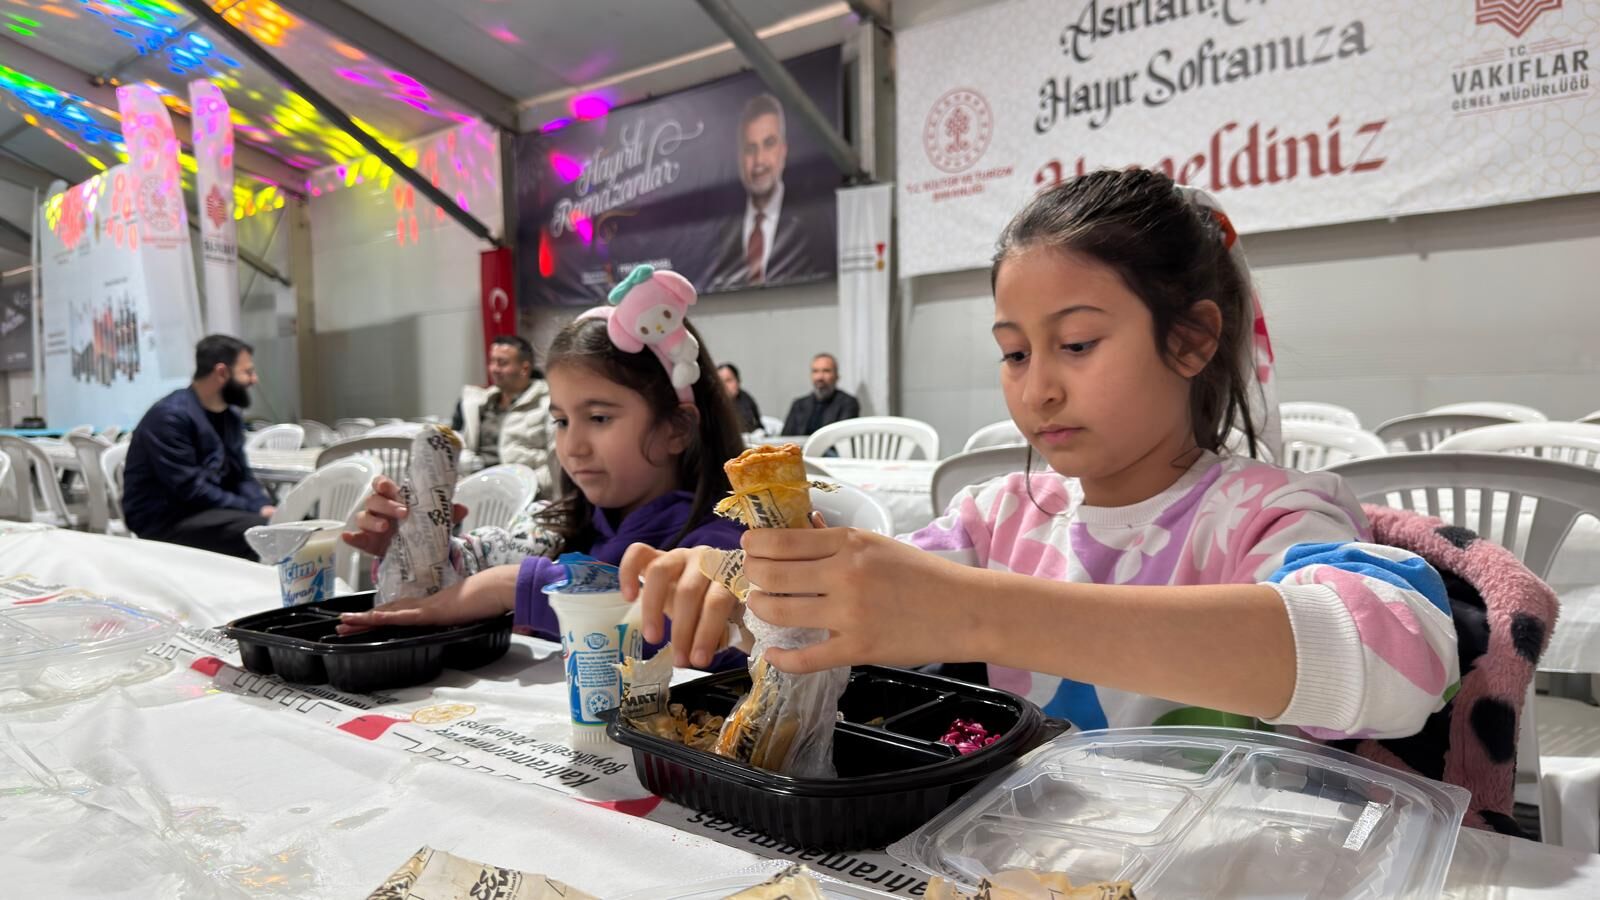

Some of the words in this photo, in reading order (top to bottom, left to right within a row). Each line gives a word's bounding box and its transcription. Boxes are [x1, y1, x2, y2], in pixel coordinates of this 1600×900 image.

[1034, 69, 1139, 135] Hayır
[1143, 18, 1374, 107] Soframıza
[1451, 95, 1493, 112] GENEL
[1499, 74, 1590, 103] MÜDÜRLÜĞÜ
[1452, 49, 1589, 95] VAKIFLAR
